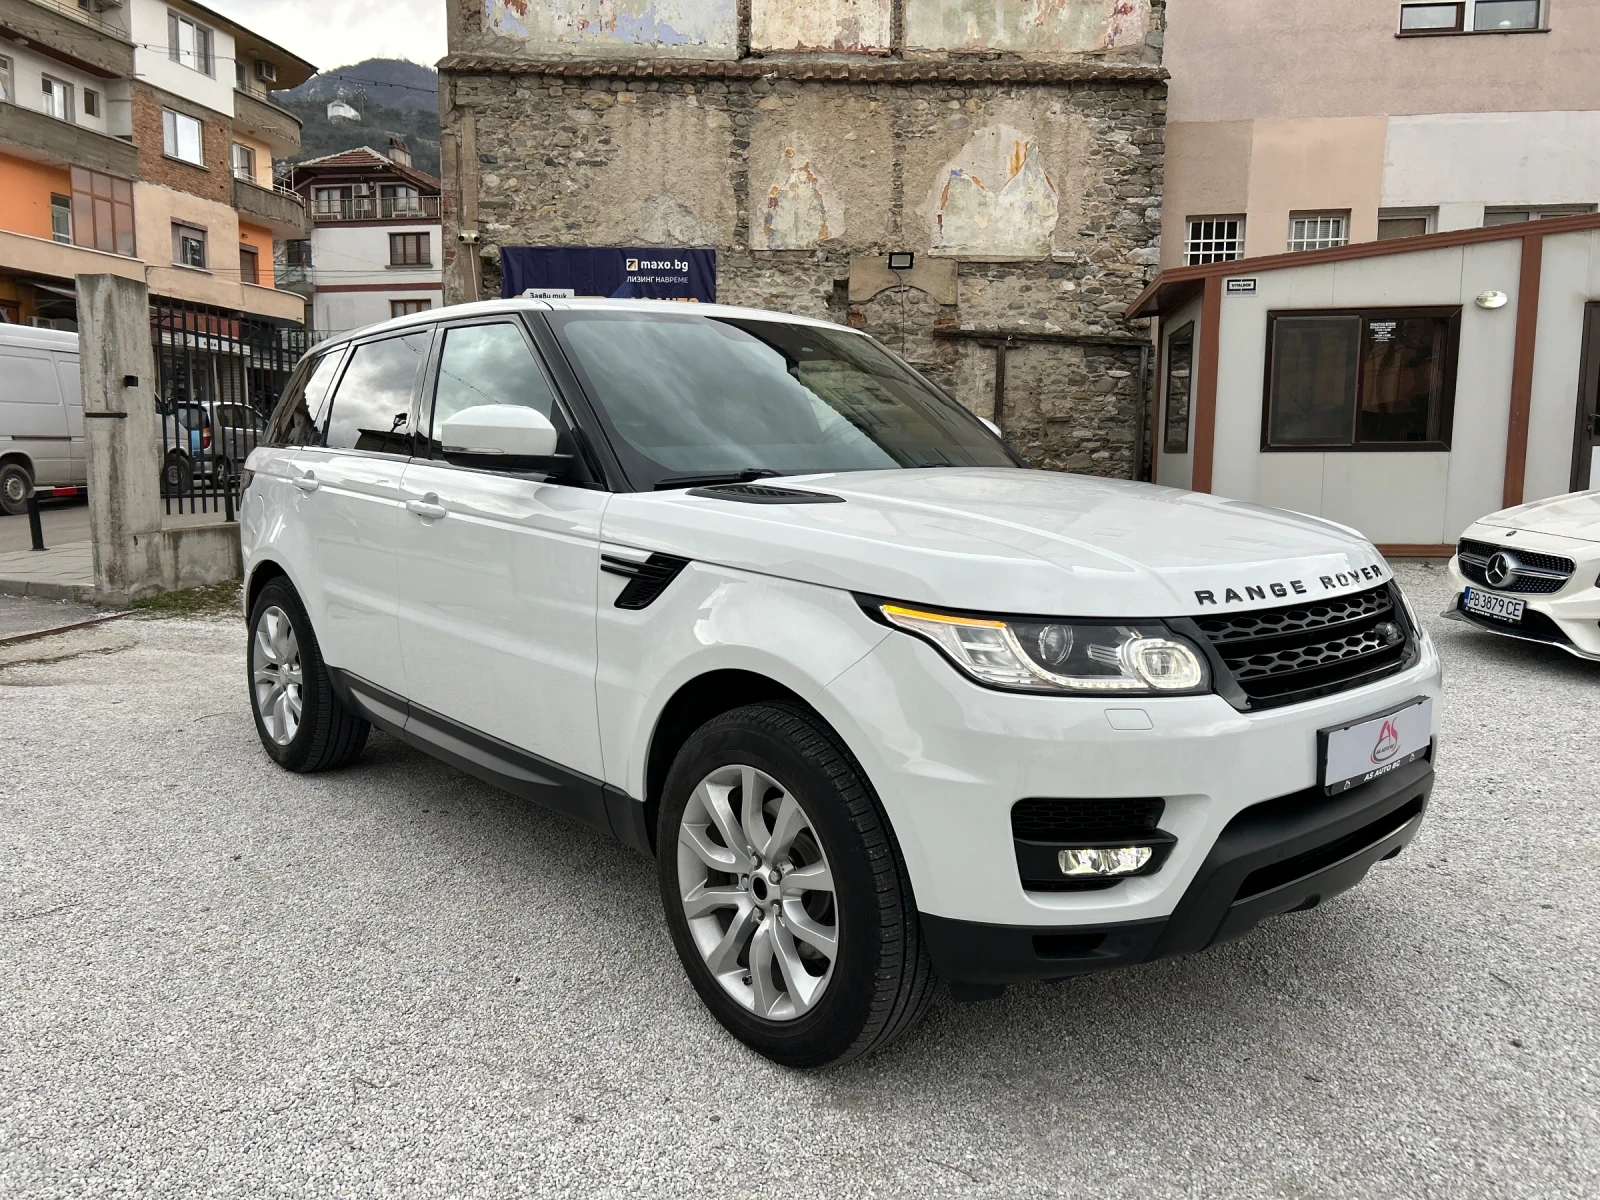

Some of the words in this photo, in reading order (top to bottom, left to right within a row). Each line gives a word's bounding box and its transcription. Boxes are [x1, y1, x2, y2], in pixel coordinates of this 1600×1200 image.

[640, 259, 689, 272] maxo.bg
[655, 276, 689, 284] НАВРЕМЕ
[1194, 580, 1307, 605] RANGE
[1318, 564, 1383, 590] ROVER
[1469, 592, 1480, 606] PB
[1481, 595, 1505, 613] 3879
[1506, 601, 1521, 617] CE
[1364, 772, 1374, 781] AS
[1374, 764, 1392, 777] AUTO
[1392, 760, 1401, 770] BG
